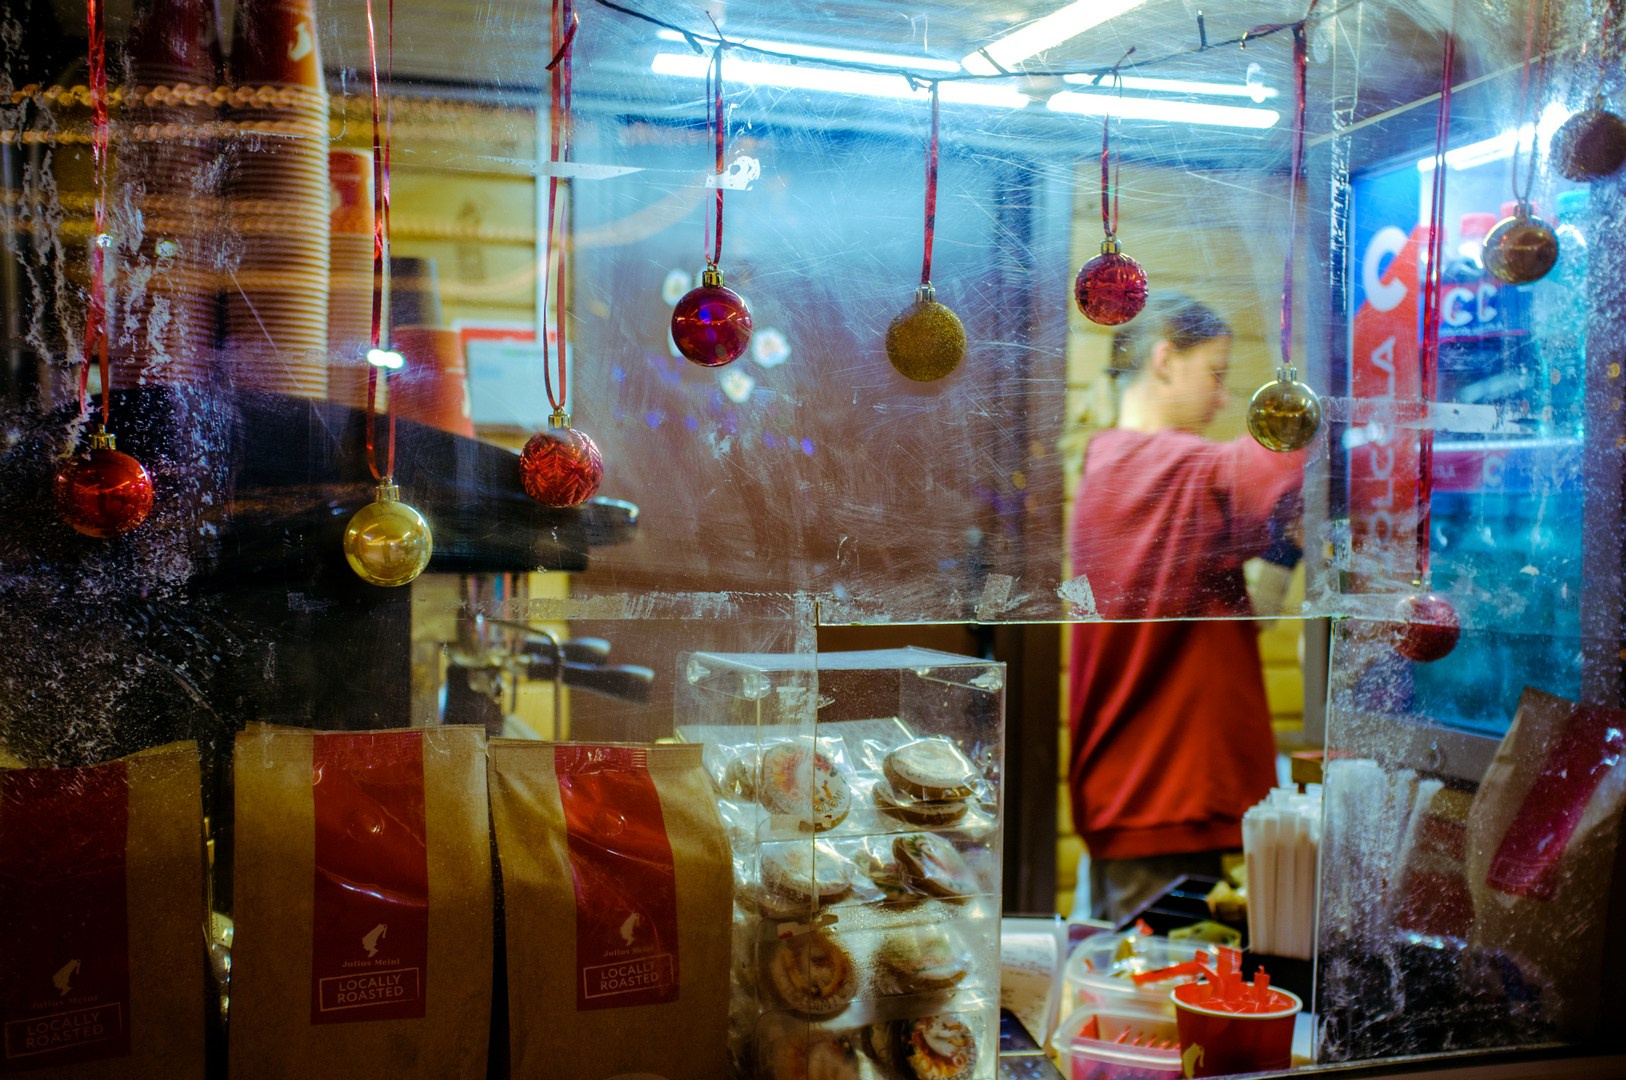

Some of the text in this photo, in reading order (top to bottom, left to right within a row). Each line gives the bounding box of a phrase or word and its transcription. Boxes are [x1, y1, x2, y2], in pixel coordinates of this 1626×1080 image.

[342, 958, 400, 968] Julius Meinl
[601, 962, 655, 980] LOCALLY
[338, 974, 401, 992] LOCALLY
[600, 972, 660, 990] ROASTED
[337, 986, 404, 1004] ROASTED
[27, 1011, 101, 1036] LOCALLY
[26, 1024, 104, 1049] ROASTED
